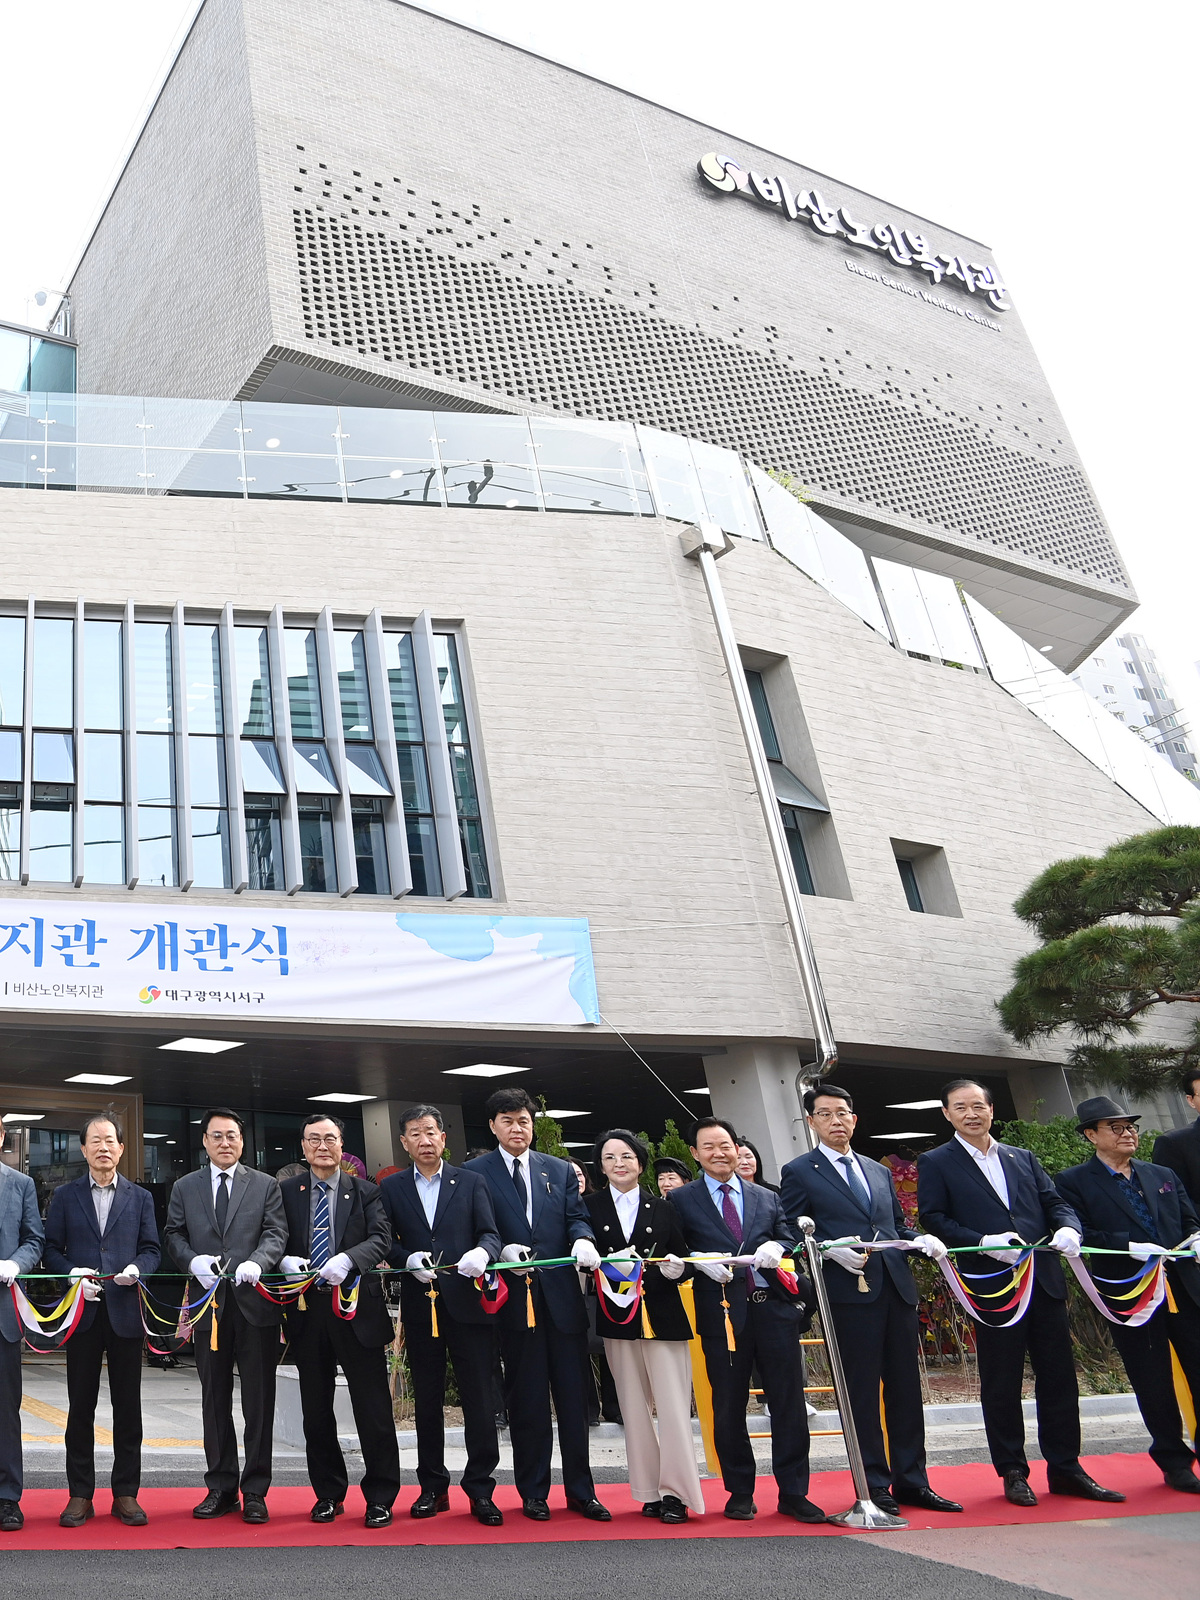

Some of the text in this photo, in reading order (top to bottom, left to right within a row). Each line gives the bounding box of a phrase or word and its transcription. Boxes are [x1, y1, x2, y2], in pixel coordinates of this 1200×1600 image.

[747, 170, 1011, 313] 비산노인복지관
[845, 259, 1002, 333] Bisan Senior Welfare Center
[127, 921, 290, 976] 개관식
[13, 982, 104, 998] 비산노인복지관
[165, 990, 266, 1004] 대구광역시서구
